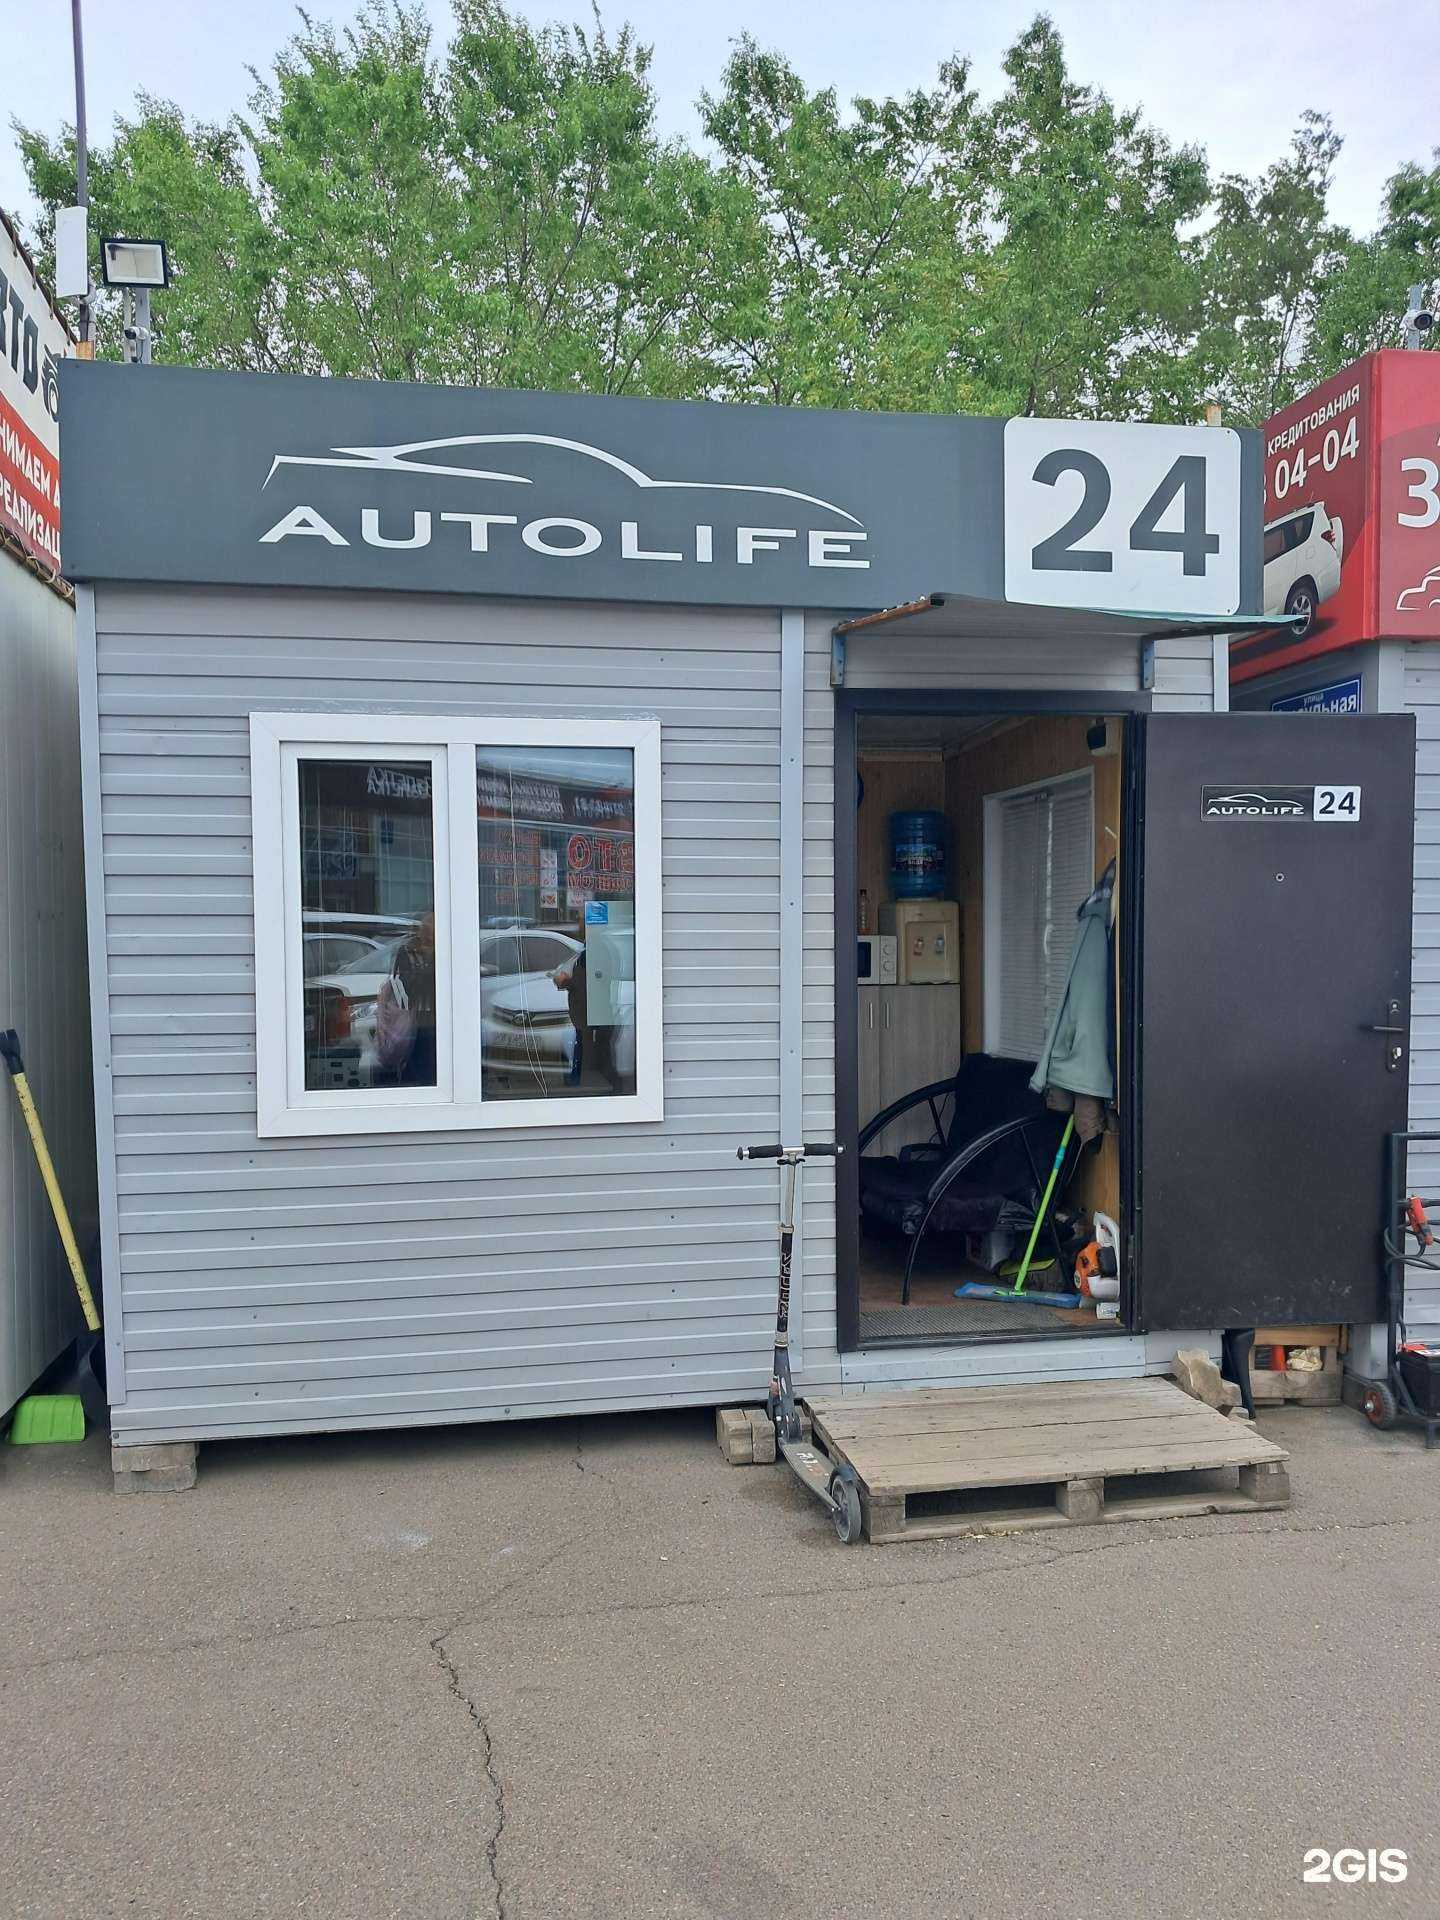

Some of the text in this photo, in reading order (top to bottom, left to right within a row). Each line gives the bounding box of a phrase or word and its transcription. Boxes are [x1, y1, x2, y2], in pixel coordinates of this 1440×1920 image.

[1267, 384, 1360, 458] КРЕДИТОВАНИЯ
[1274, 416, 1360, 499] 04-04
[258, 505, 871, 569] AUTOLIFE
[1031, 448, 1220, 577] 24
[1206, 806, 1305, 815] AUTOLIFE
[1318, 791, 1356, 815] 24
